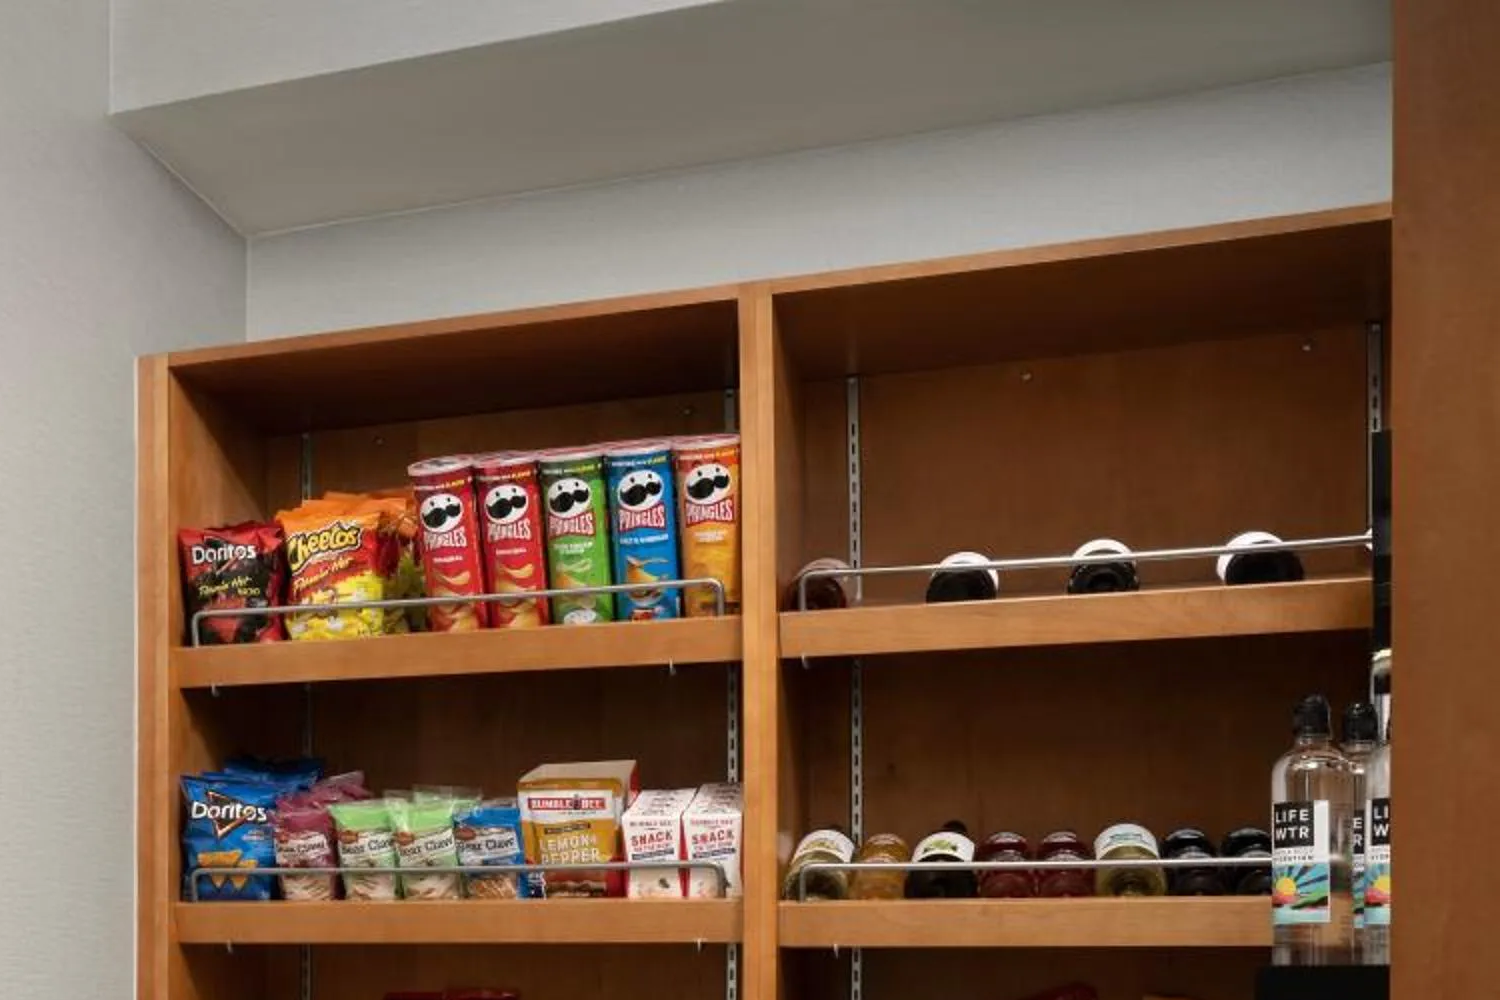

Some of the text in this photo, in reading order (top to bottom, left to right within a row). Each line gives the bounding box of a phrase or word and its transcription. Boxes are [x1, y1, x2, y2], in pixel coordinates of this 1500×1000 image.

[618, 505, 666, 529] PRINGLES
[685, 499, 734, 522] PRINGLES
[191, 543, 257, 565] Doritos
[287, 525, 361, 569] Cheetos
[191, 801, 267, 823] Doritos
[1274, 808, 1310, 824] LIFE
[631, 830, 674, 846] SNACK
[691, 829, 735, 846] SNACK
[1275, 827, 1310, 842] WTR
[539, 836, 588, 851] LEMON
[541, 848, 600, 864] PEPPER
